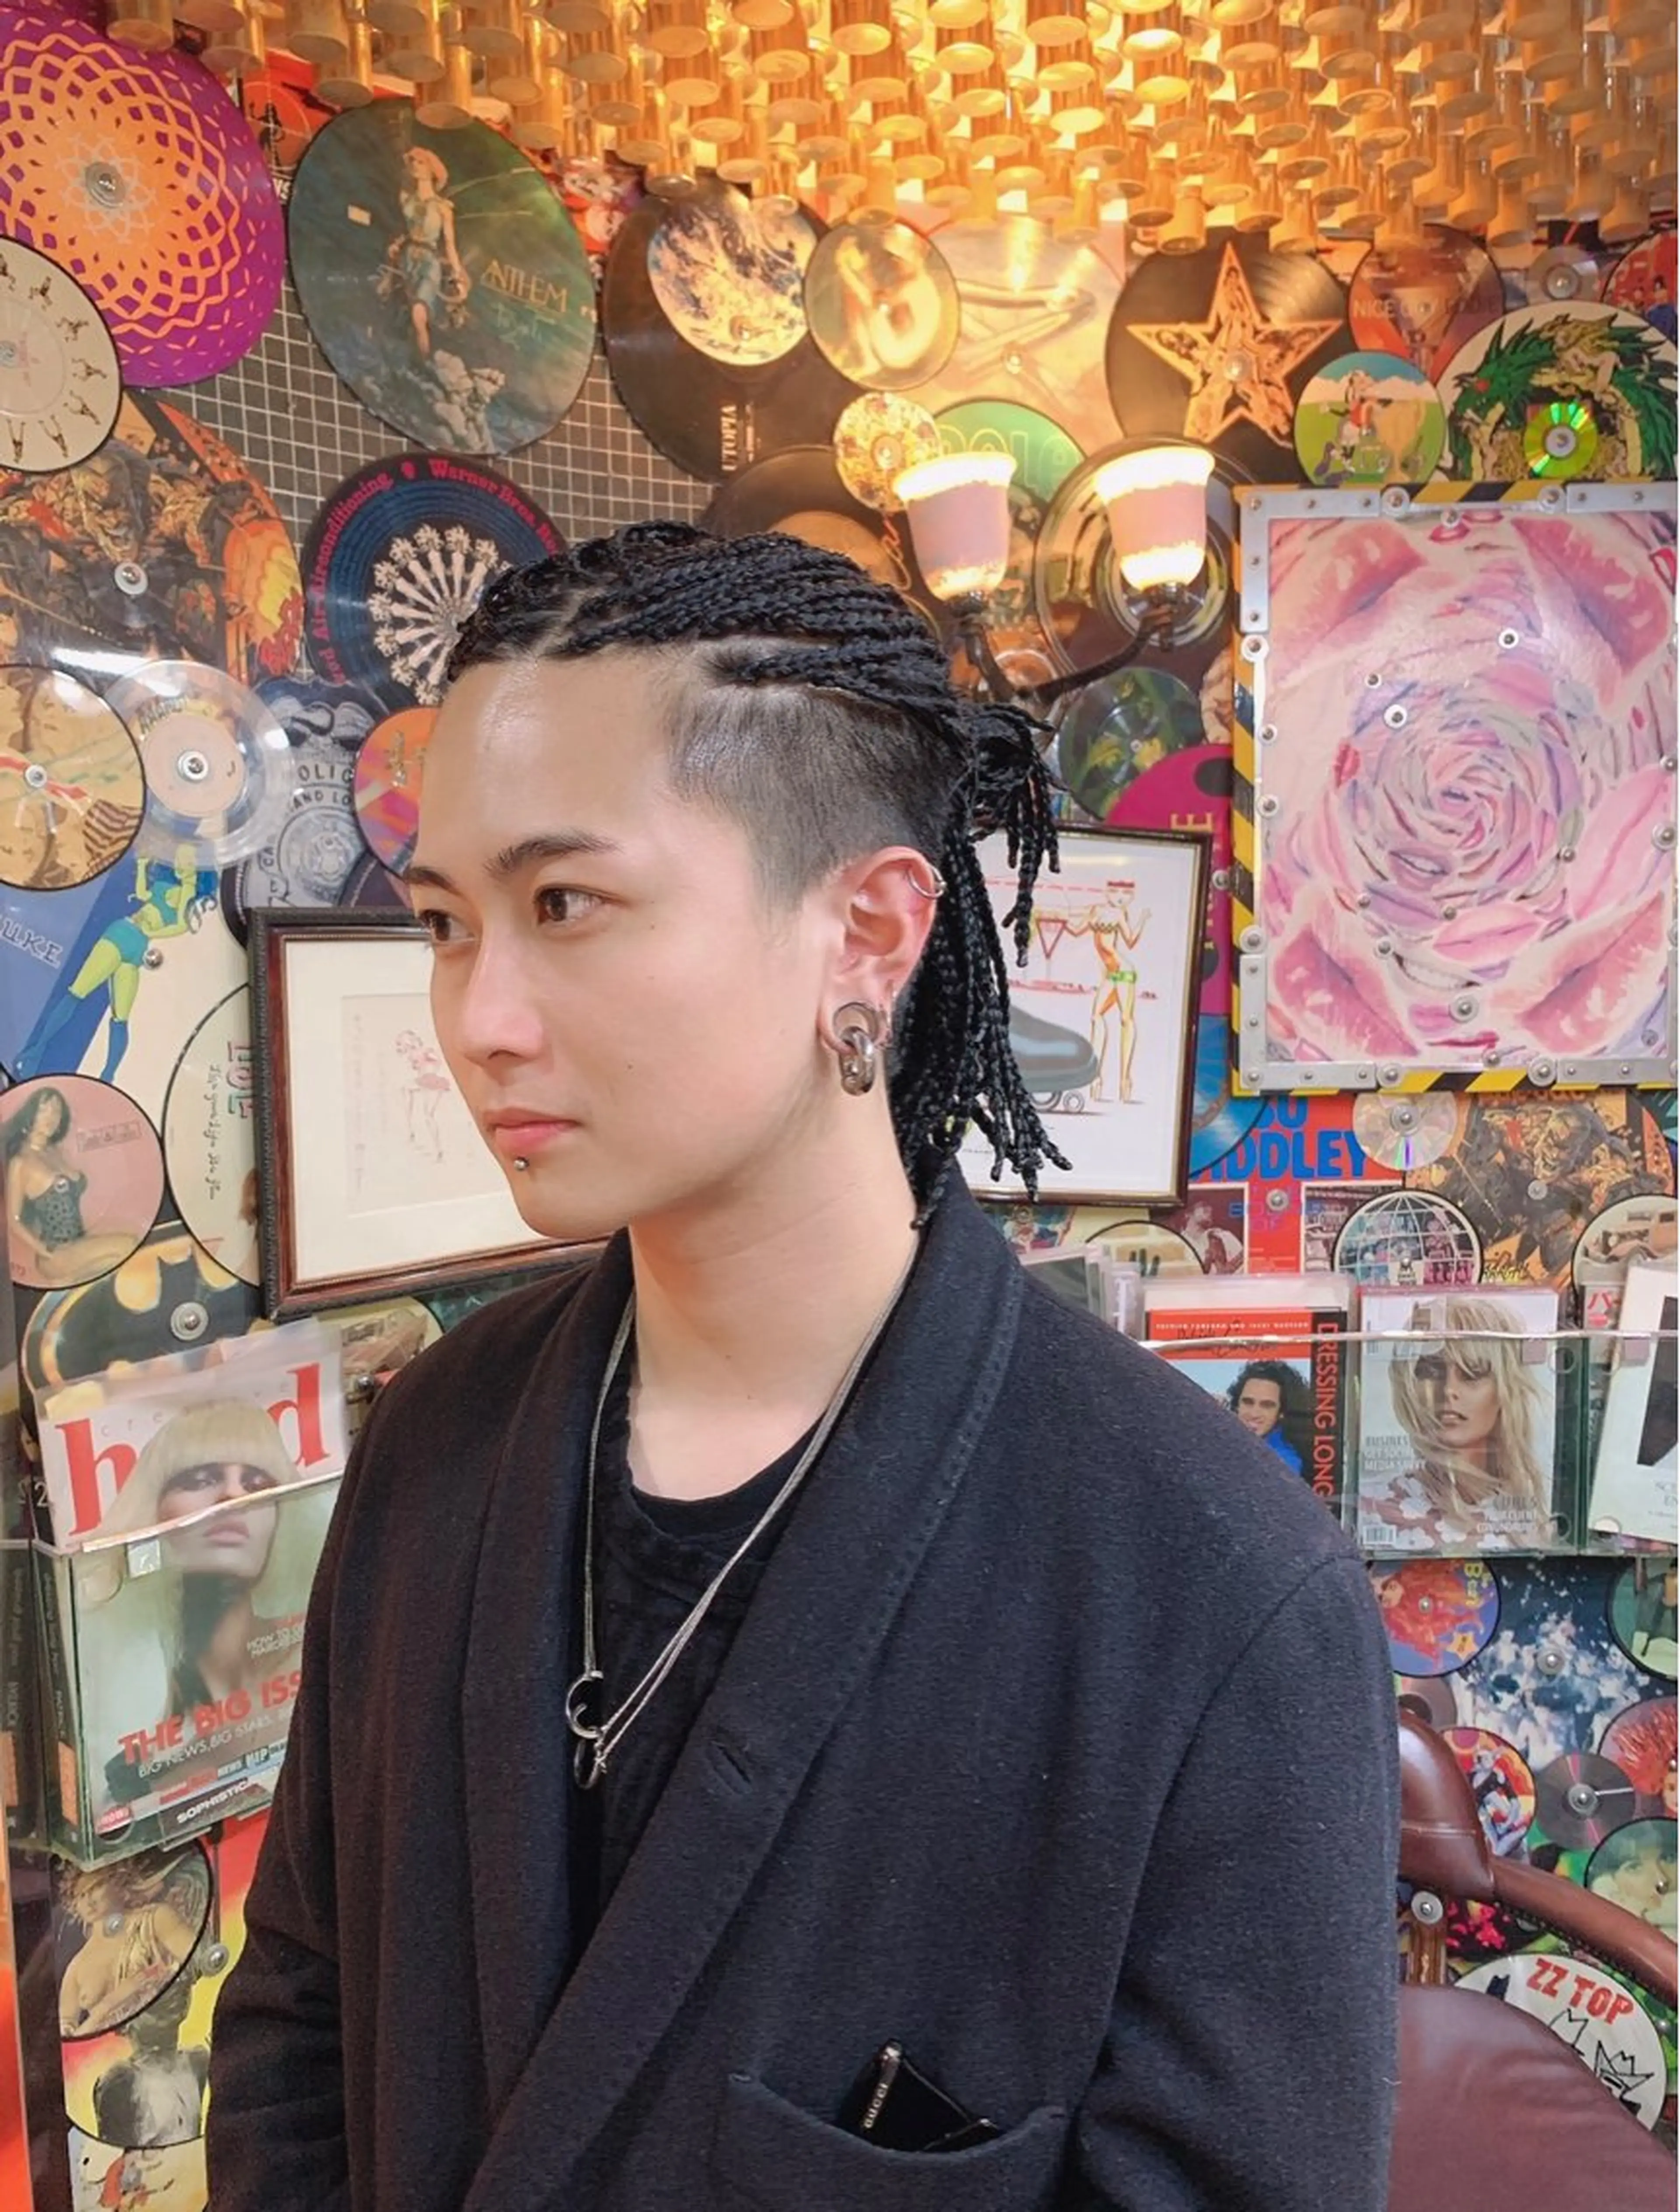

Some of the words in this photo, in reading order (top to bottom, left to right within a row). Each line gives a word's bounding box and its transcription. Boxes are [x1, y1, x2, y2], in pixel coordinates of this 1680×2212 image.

[480, 259, 568, 313] ANTHEM
[720, 405, 737, 472] UTOPIA
[0, 917, 64, 970] UKE
[1189, 1130, 1367, 1181] DDLEY
[1314, 1322, 1339, 1429] DRESSING
[1313, 1436, 1336, 1498] LONG
[118, 1713, 184, 1766] THE
[195, 1688, 252, 1737] BIG
[1526, 1958, 1569, 1998] ZZ
[1568, 1974, 1636, 2025] TOP
